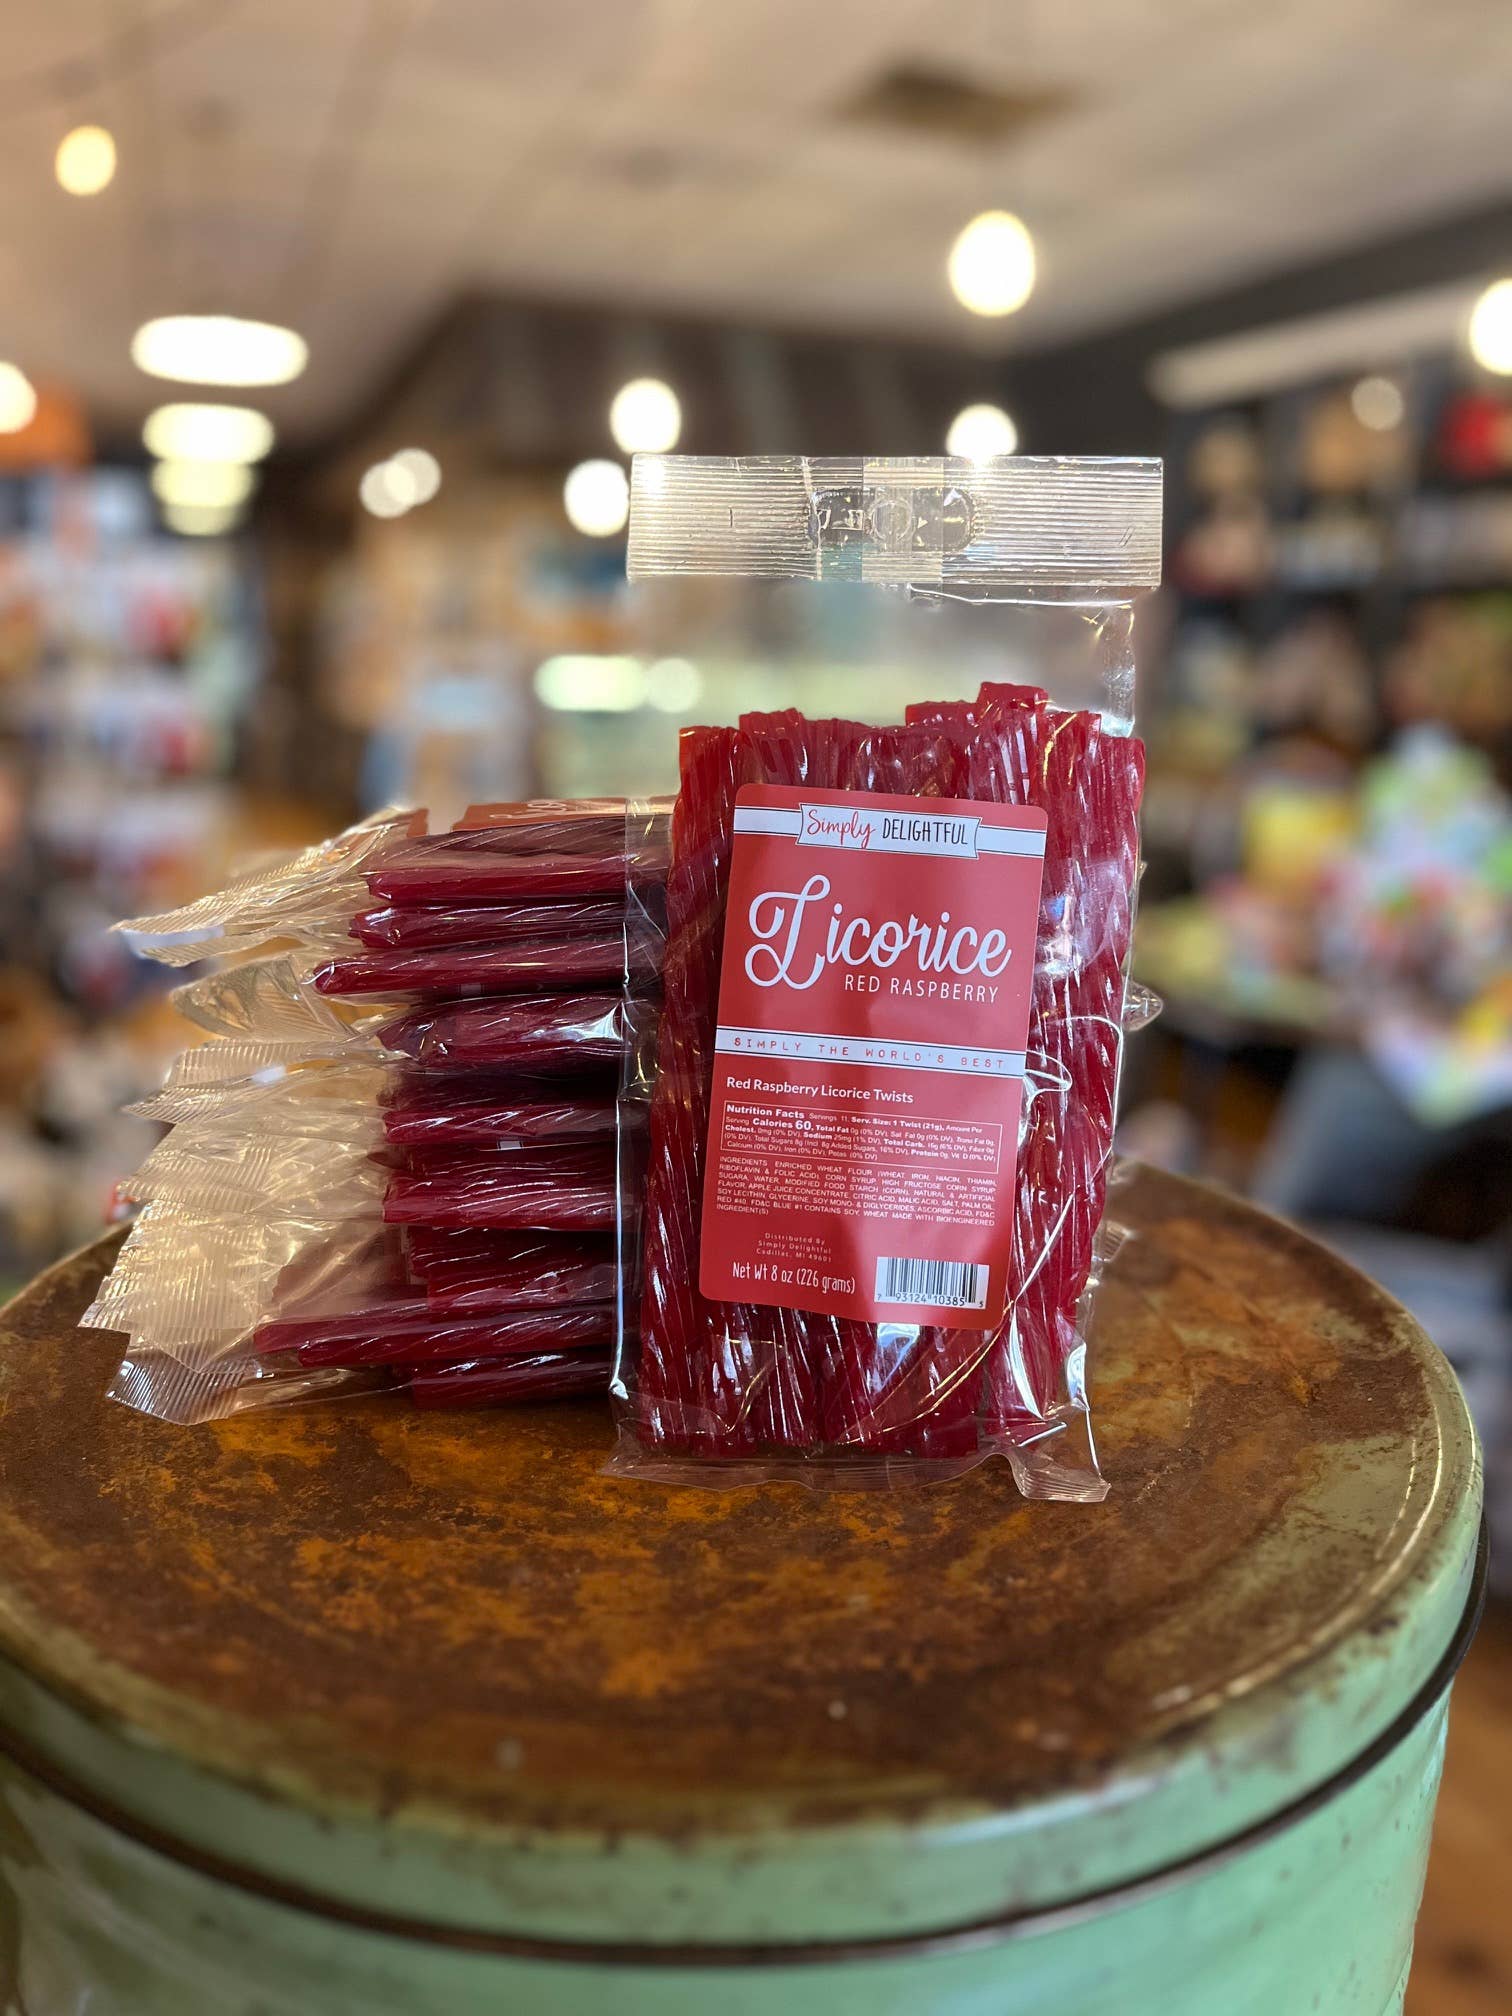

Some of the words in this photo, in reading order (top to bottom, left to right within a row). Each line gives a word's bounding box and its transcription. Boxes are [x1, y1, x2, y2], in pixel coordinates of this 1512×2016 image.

[807, 809, 875, 848] Simply
[882, 818, 968, 845] DELIGHTFUL
[745, 874, 1012, 990] Licorice
[844, 974, 880, 993] RED
[889, 976, 999, 1003] RASPBERRY
[734, 1037, 803, 1051] SIMPLY
[818, 1044, 850, 1056] THE
[960, 1056, 1005, 1069] BEST
[726, 1076, 751, 1090] Red
[753, 1079, 819, 1098] Raspberry
[821, 1085, 871, 1100] Licorice
[873, 1089, 914, 1104] Twists
[726, 1104, 773, 1116] Nutrition
[775, 1109, 805, 1119] Facts
[851, 1116, 872, 1124] Serv.
[900, 1120, 921, 1129] Twist
[752, 1117, 793, 1129] Calories
[815, 1124, 836, 1132] Total
[836, 1126, 849, 1134] Fat
[803, 1131, 833, 1140] Sodium
[883, 1139, 904, 1147] Total
[910, 1149, 939, 1158] Protein
[748, 1183, 772, 1191] APPLE
[773, 1185, 793, 1193] JUICE
[852, 1192, 877, 1200] CITRIC
[813, 1196, 828, 1204] SOY
[732, 1262, 750, 1279] Net
[754, 1263, 768, 1281] Wt
[771, 1265, 778, 1281] 8
[781, 1270, 793, 1283] oz
[796, 1268, 819, 1288] (226
[822, 1276, 856, 1294] grams)
[933, 1295, 966, 1307] 10385
